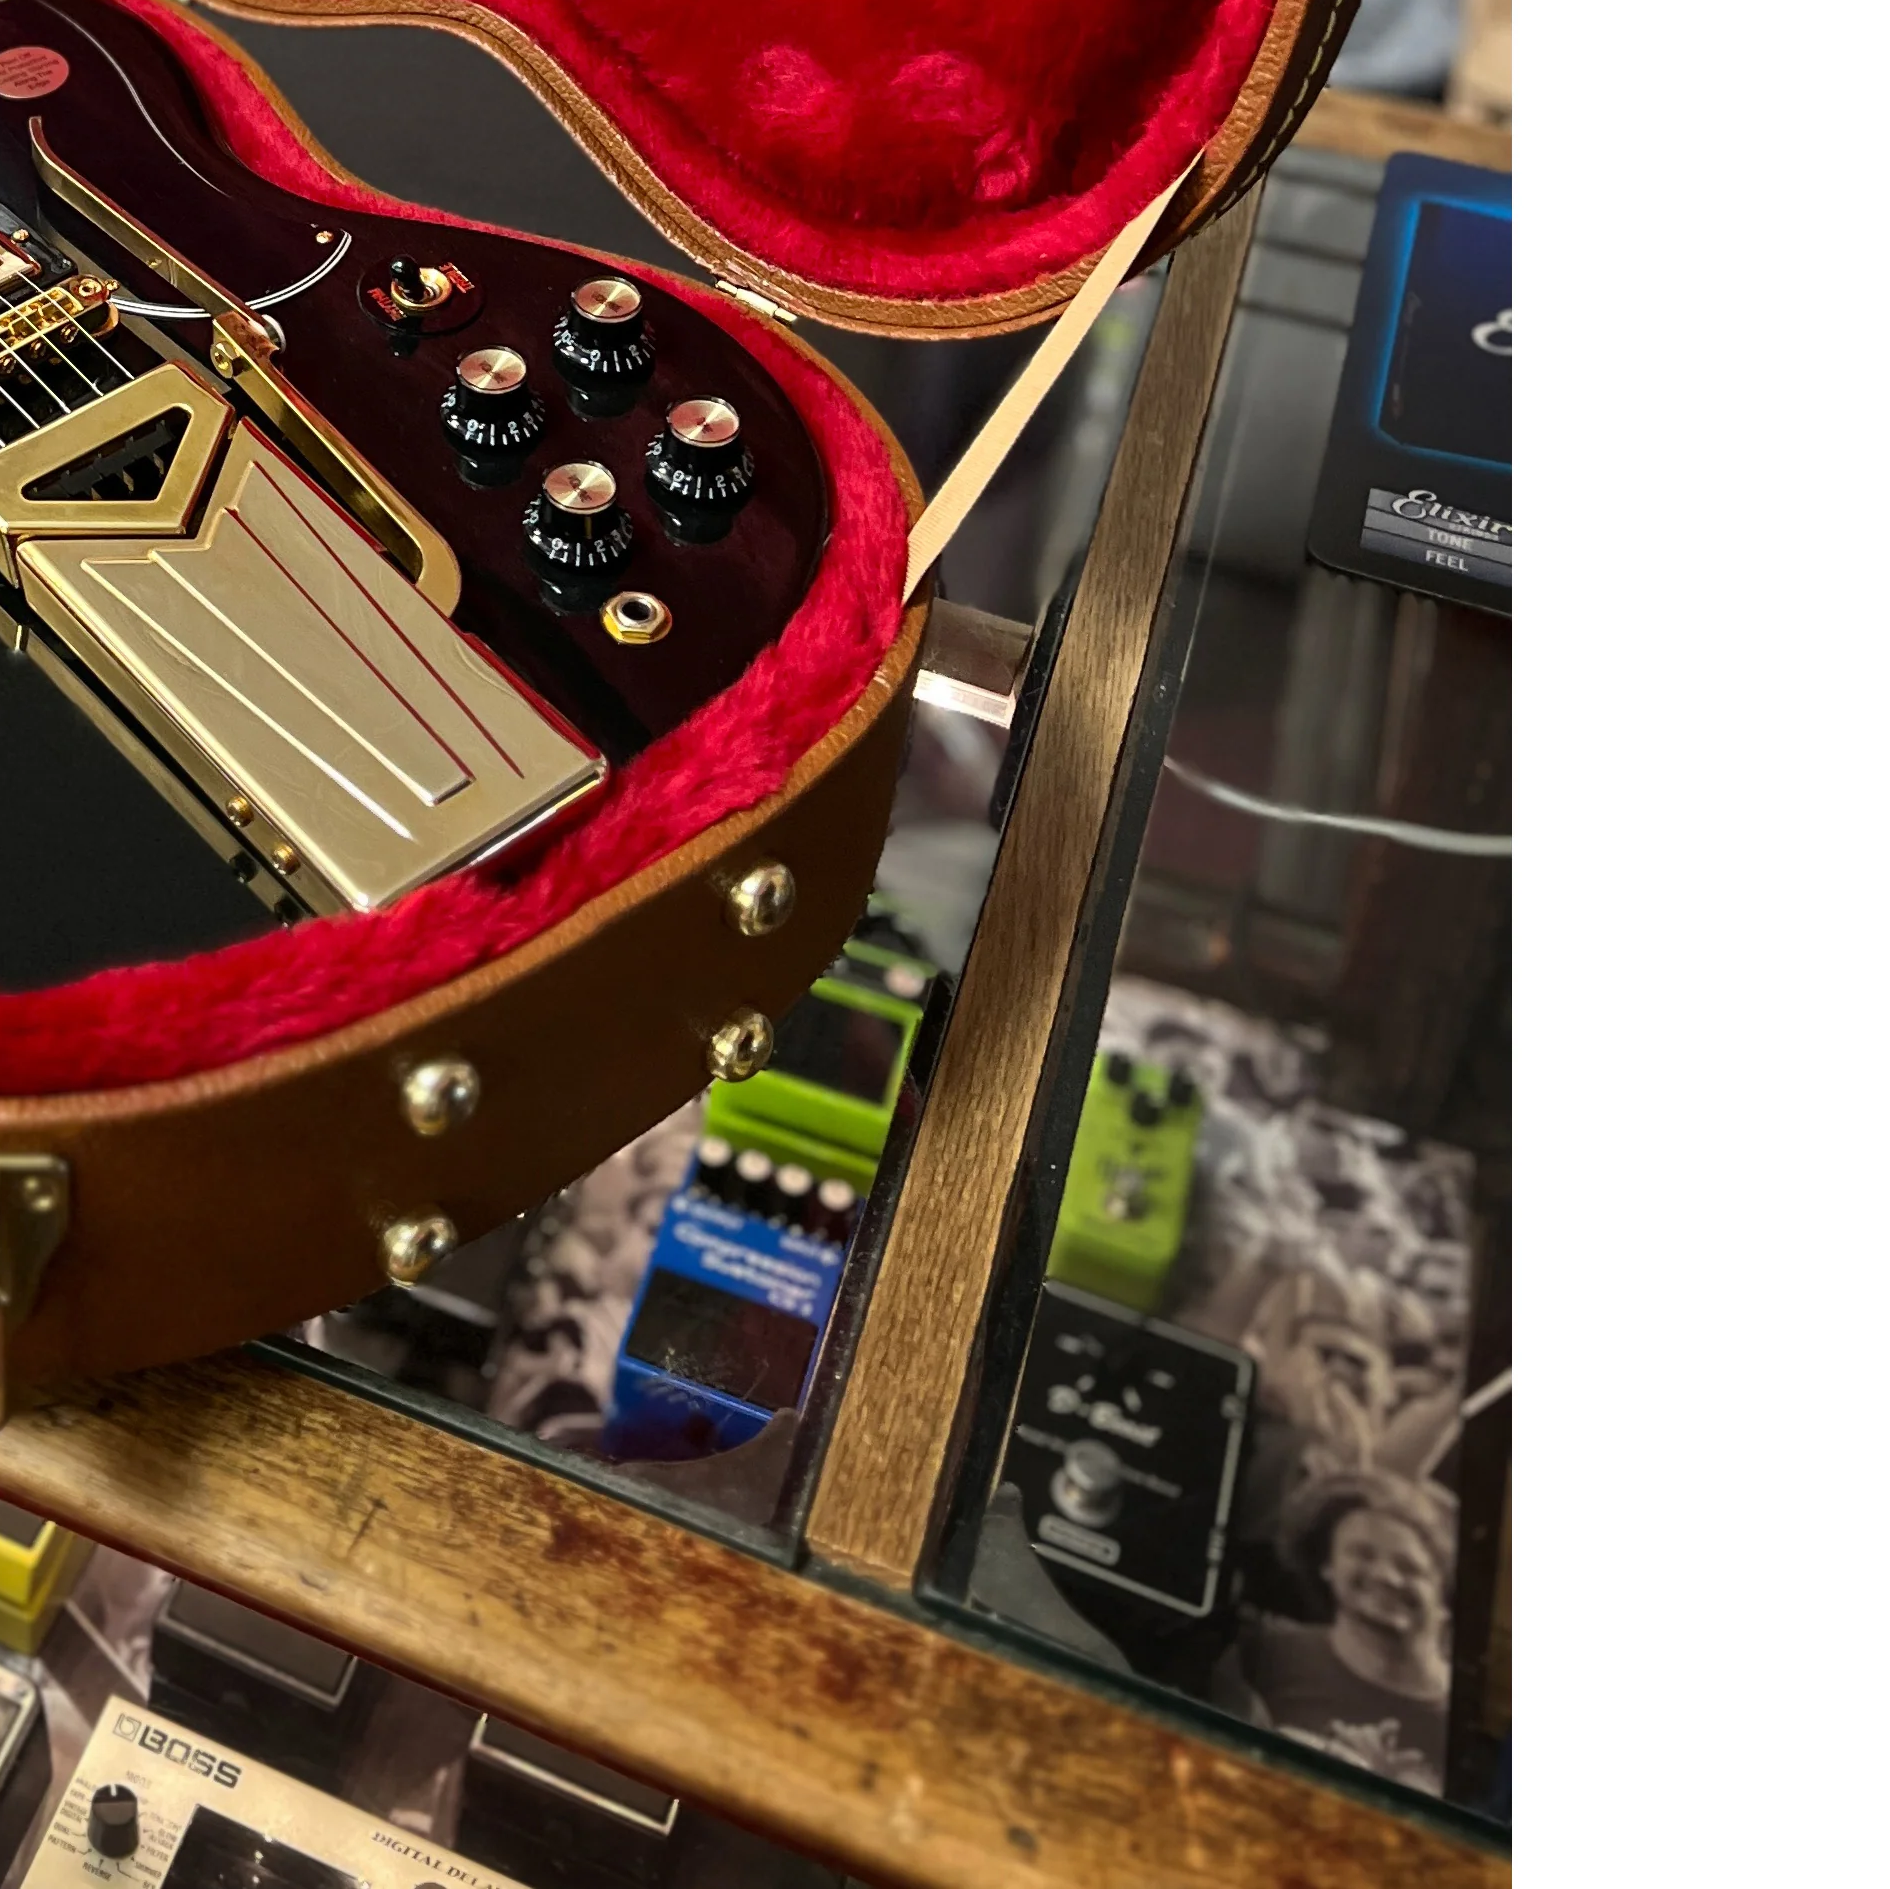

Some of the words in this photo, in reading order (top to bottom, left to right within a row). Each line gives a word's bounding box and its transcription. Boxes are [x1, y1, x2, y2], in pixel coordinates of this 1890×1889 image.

[1392, 489, 1512, 533] Elixir
[1426, 528, 1474, 551] TONE
[1425, 550, 1469, 572] FEEL
[138, 1724, 242, 1789] BOSS
[47, 1833, 77, 1854] PATTERN
[82, 1861, 113, 1882] REVERSE
[371, 1831, 441, 1872] DIGITAL
[446, 1865, 500, 1889] DEL
